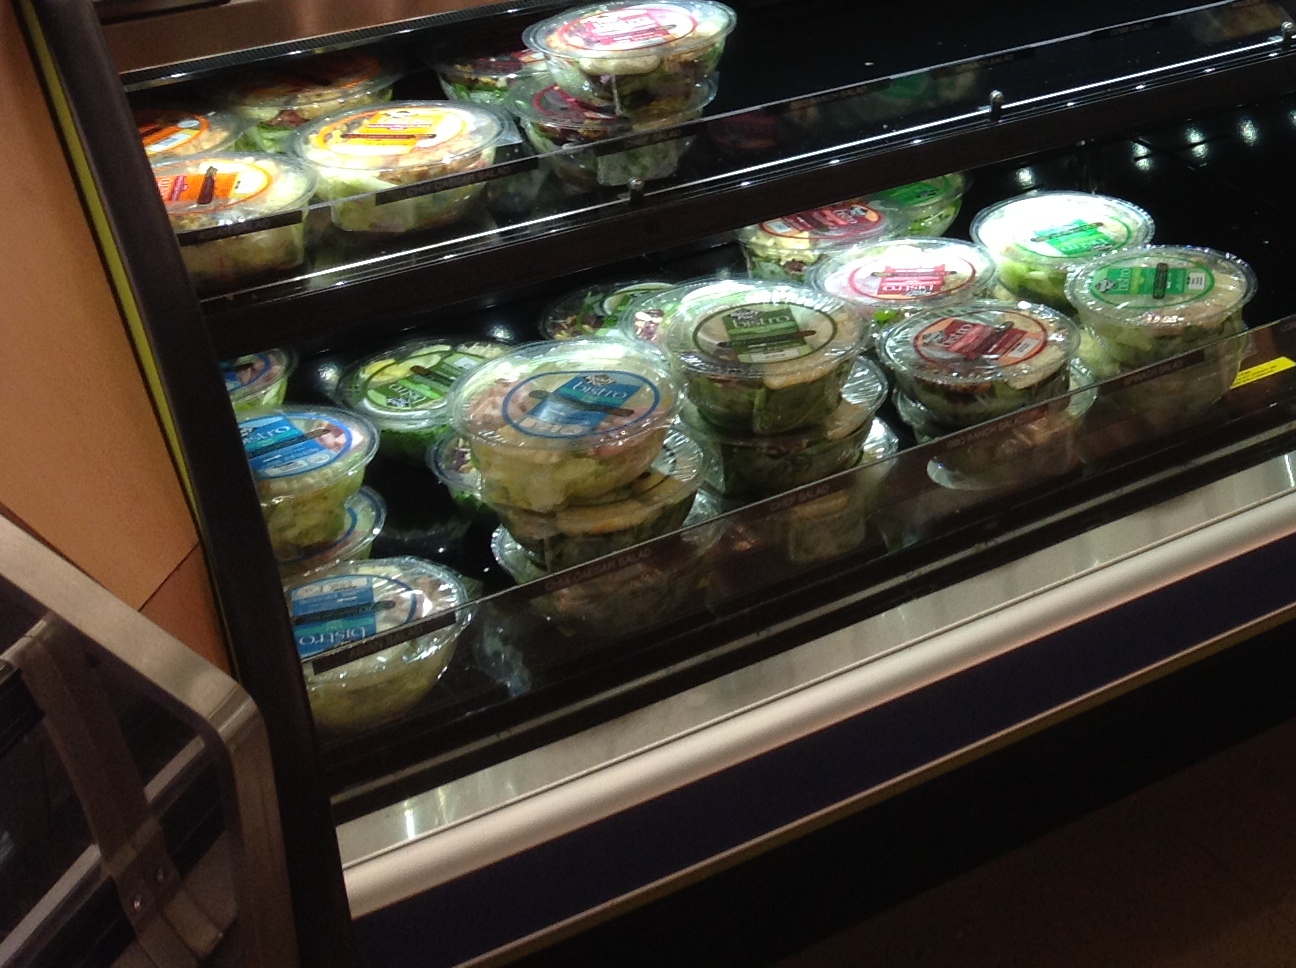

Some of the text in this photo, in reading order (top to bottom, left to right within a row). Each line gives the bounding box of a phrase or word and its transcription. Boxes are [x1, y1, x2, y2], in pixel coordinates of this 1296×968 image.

[733, 314, 790, 329] bistro
[572, 381, 628, 399] bistro
[300, 627, 366, 645] bistro
